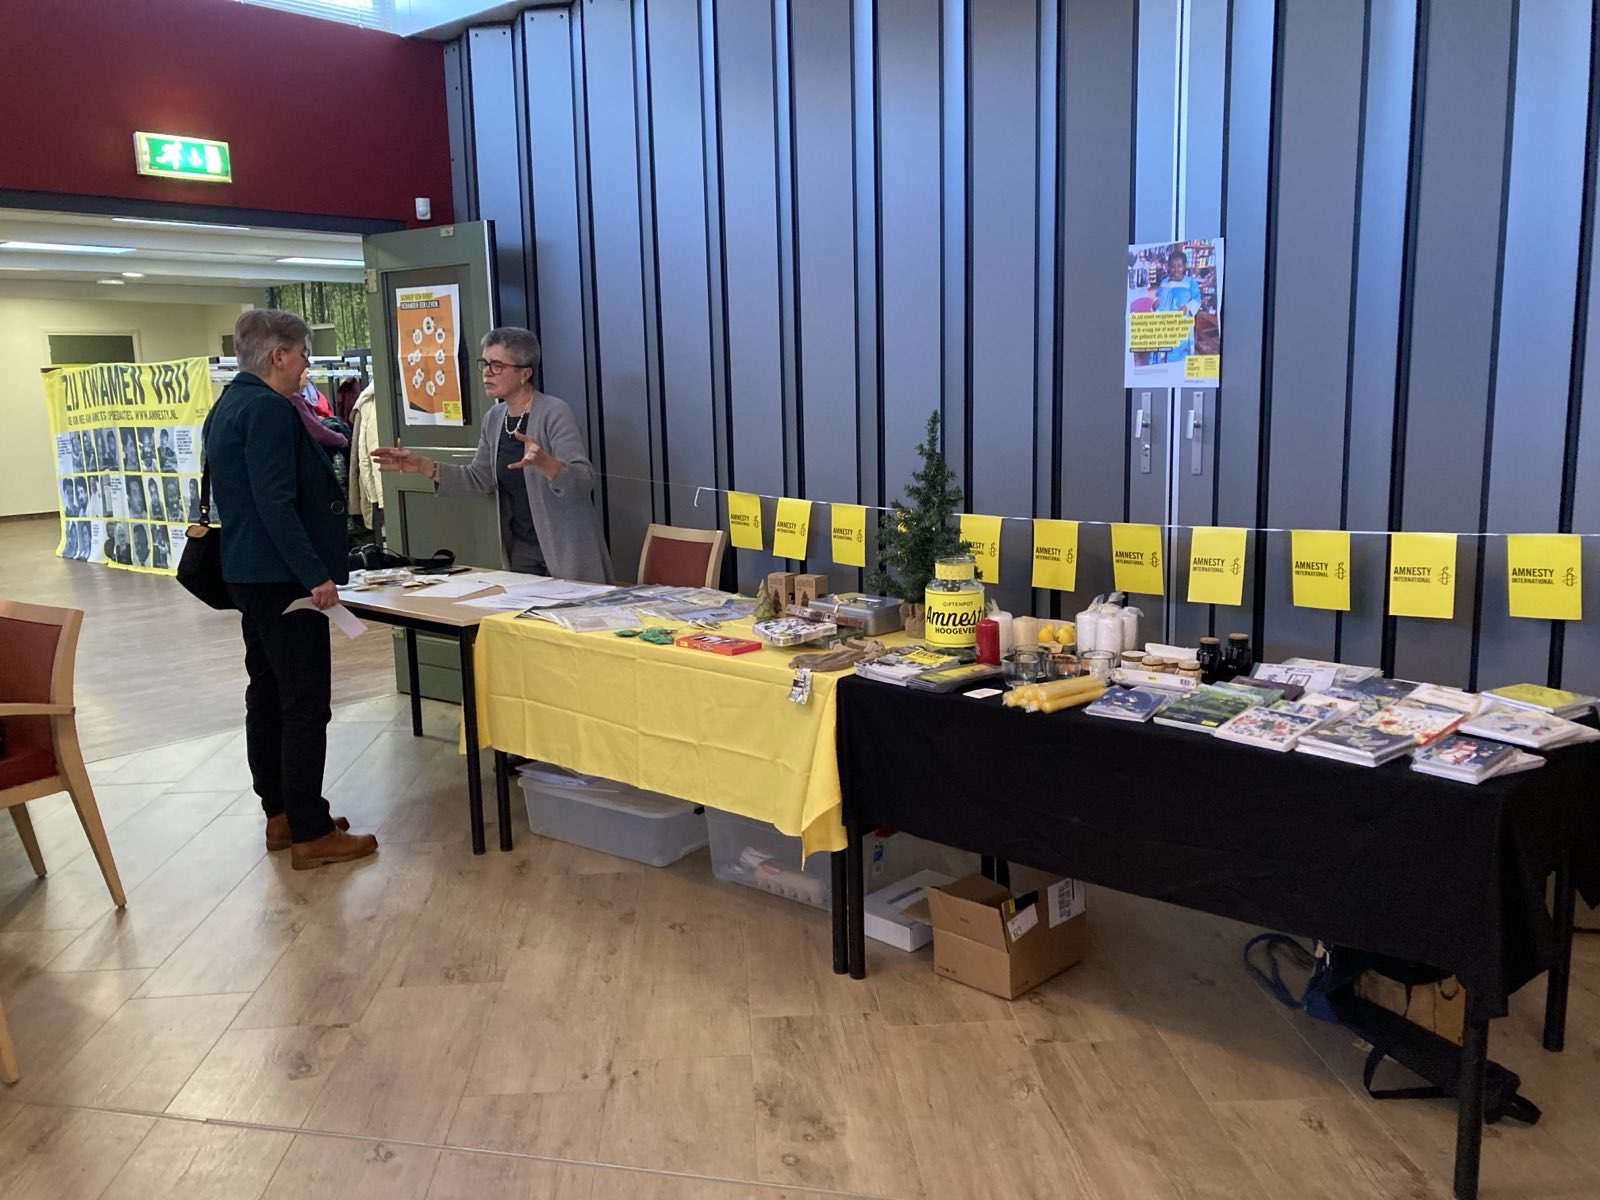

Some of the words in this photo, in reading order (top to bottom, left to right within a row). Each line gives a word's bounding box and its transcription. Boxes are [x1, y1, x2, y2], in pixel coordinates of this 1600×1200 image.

[80, 365, 145, 409] KWAMEN
[148, 362, 191, 404] VRIJ
[730, 514, 750, 522] AMNESTY
[777, 520, 796, 529] AMNESTY
[833, 527, 853, 536] AMNESTY
[1036, 546, 1061, 556] AMNESTY
[1115, 551, 1144, 560] AMNESTY
[1192, 557, 1225, 567] AMNESTY
[1295, 561, 1328, 571] AMNESTY
[1394, 566, 1432, 576] AMNESTY
[1512, 568, 1554, 578] AMNESTY
